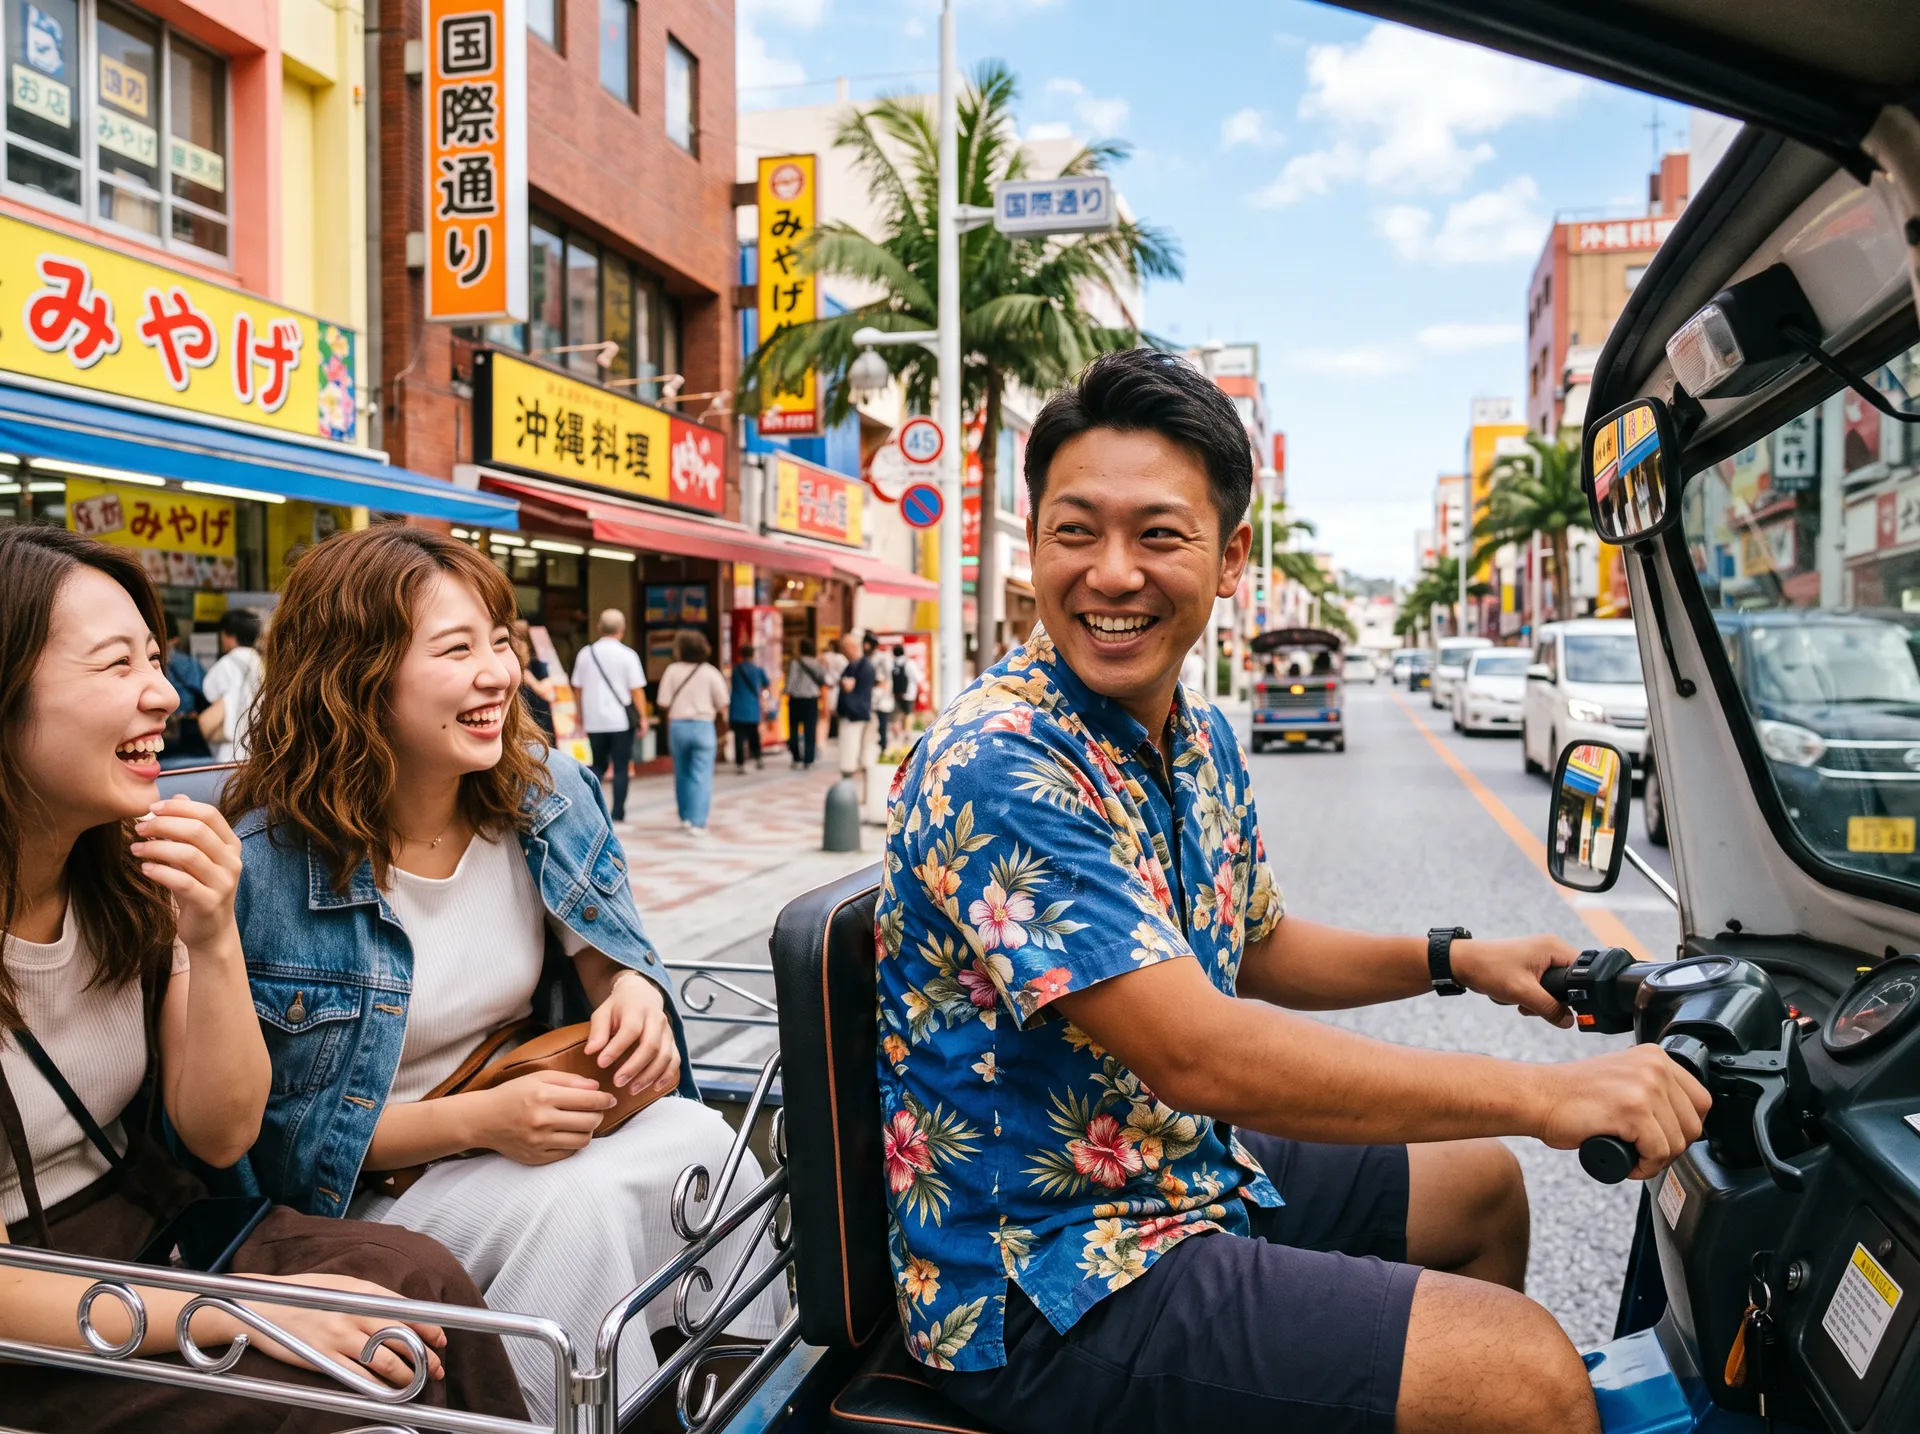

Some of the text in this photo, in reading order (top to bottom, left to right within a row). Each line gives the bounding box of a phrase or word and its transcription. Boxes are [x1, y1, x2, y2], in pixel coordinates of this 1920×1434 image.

[441, 15, 495, 285] 国際通り
[1004, 188, 1102, 219] 国際通り
[27, 256, 302, 410] みやげ
[515, 396, 651, 481] 沖縄料理
[908, 431, 937, 452] 45
[130, 501, 233, 548] みやげ
